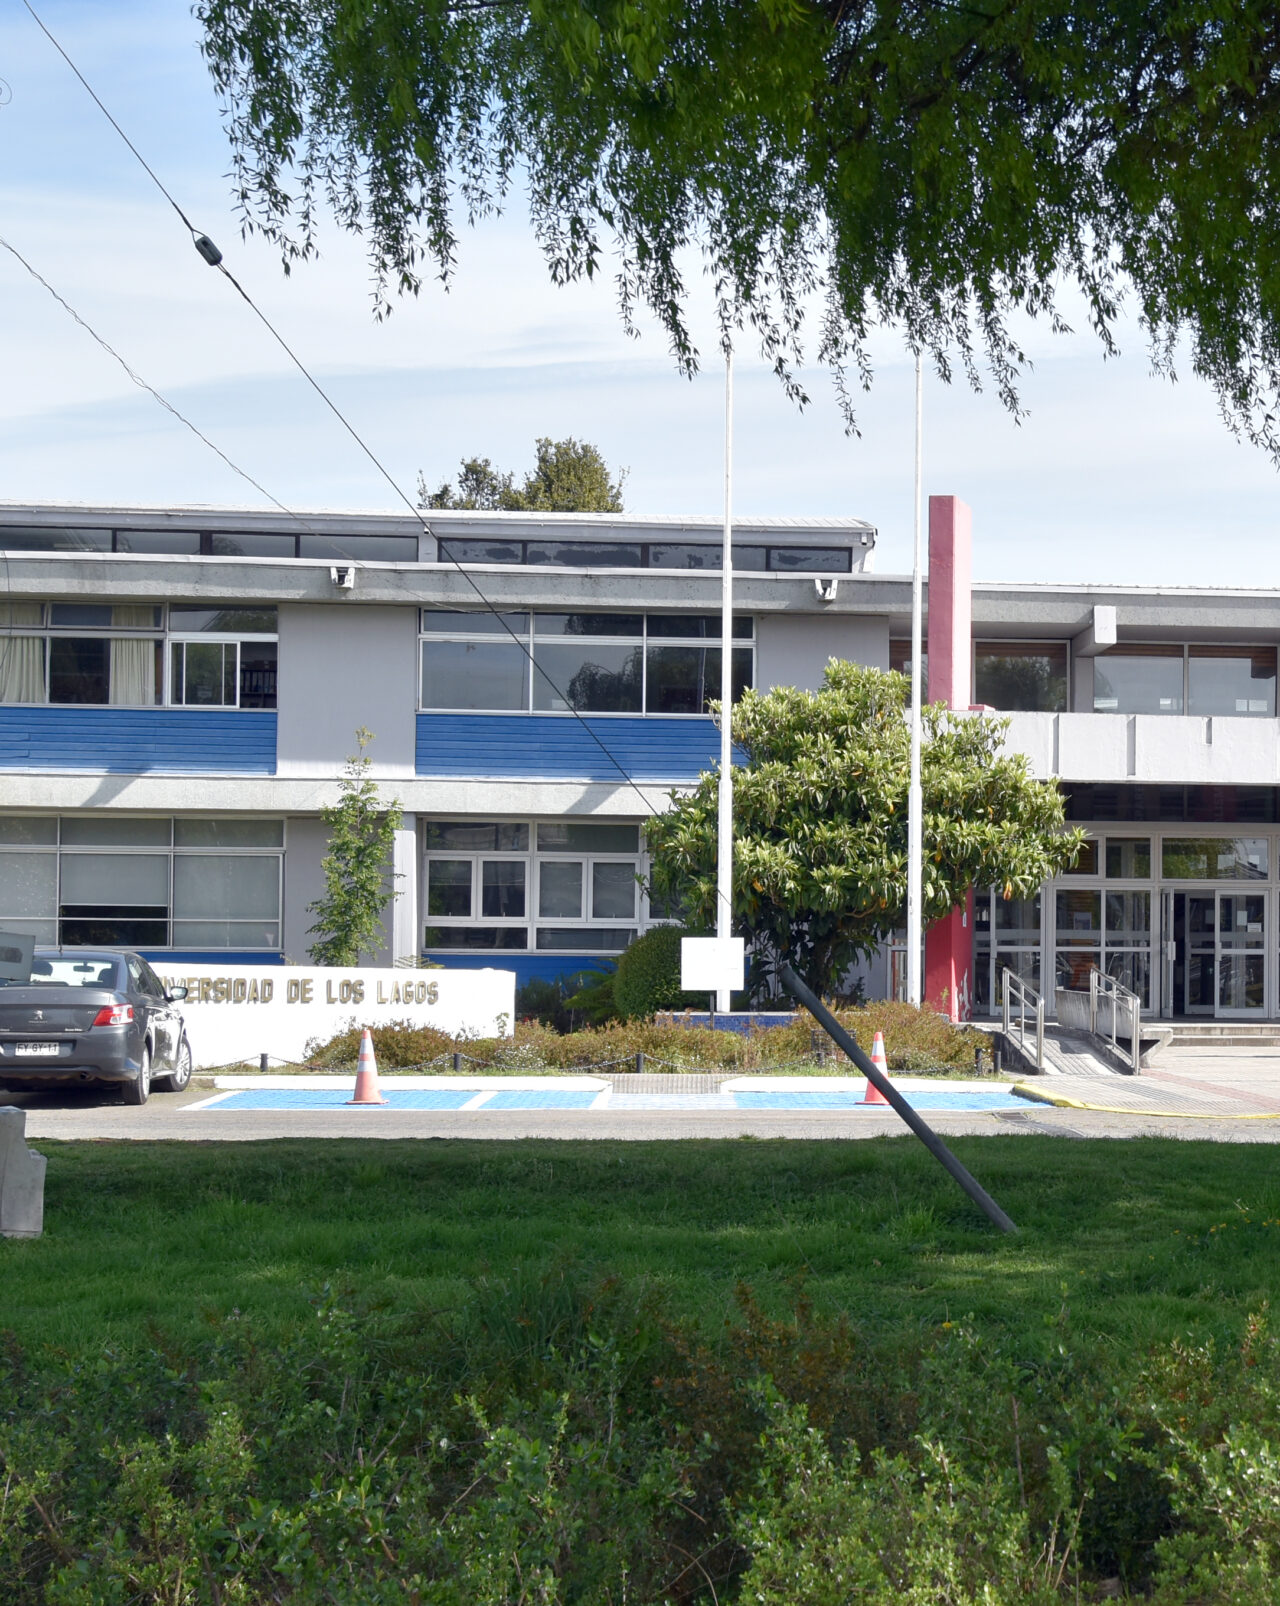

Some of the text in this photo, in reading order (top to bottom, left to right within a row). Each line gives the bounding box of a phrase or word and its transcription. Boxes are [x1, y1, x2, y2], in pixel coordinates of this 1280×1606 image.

[286, 978, 313, 1004] DE
[326, 979, 365, 1004] LOS
[377, 980, 439, 1005] LAGOS
